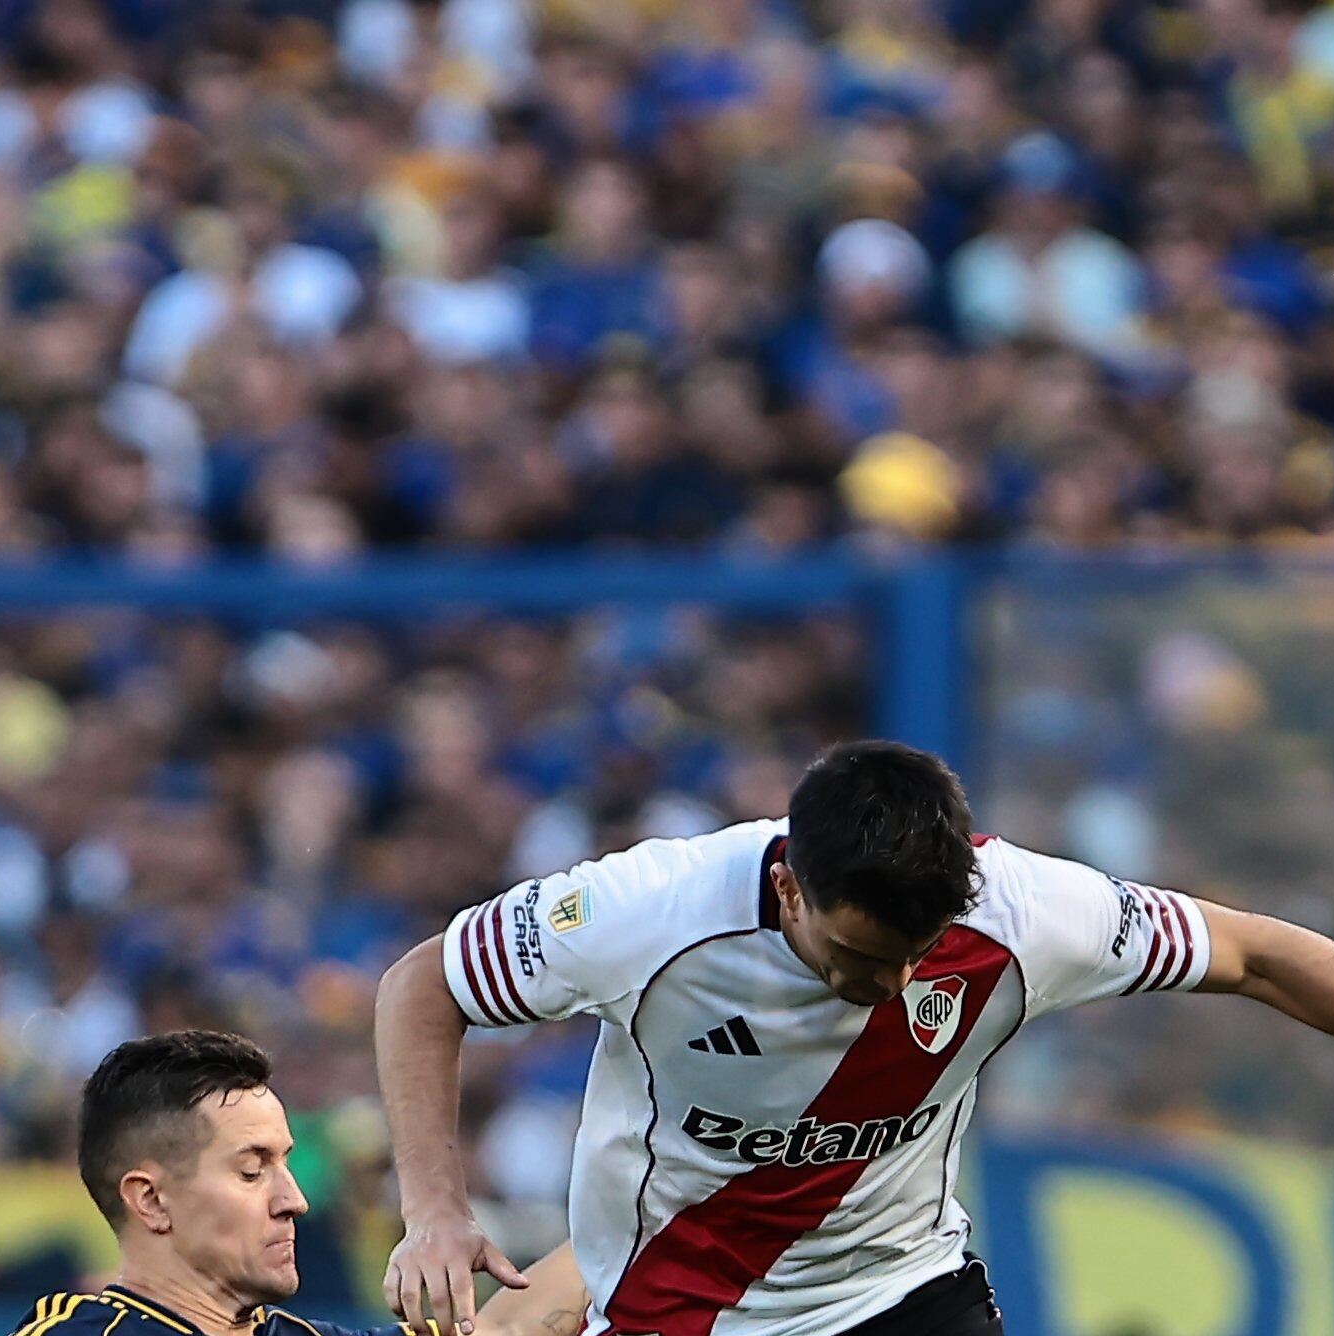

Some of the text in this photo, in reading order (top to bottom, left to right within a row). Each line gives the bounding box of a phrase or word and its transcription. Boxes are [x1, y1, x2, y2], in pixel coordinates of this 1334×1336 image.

[513, 904, 535, 977] CARD
[916, 992, 954, 1028] CARP
[680, 1103, 943, 1168] Betano
